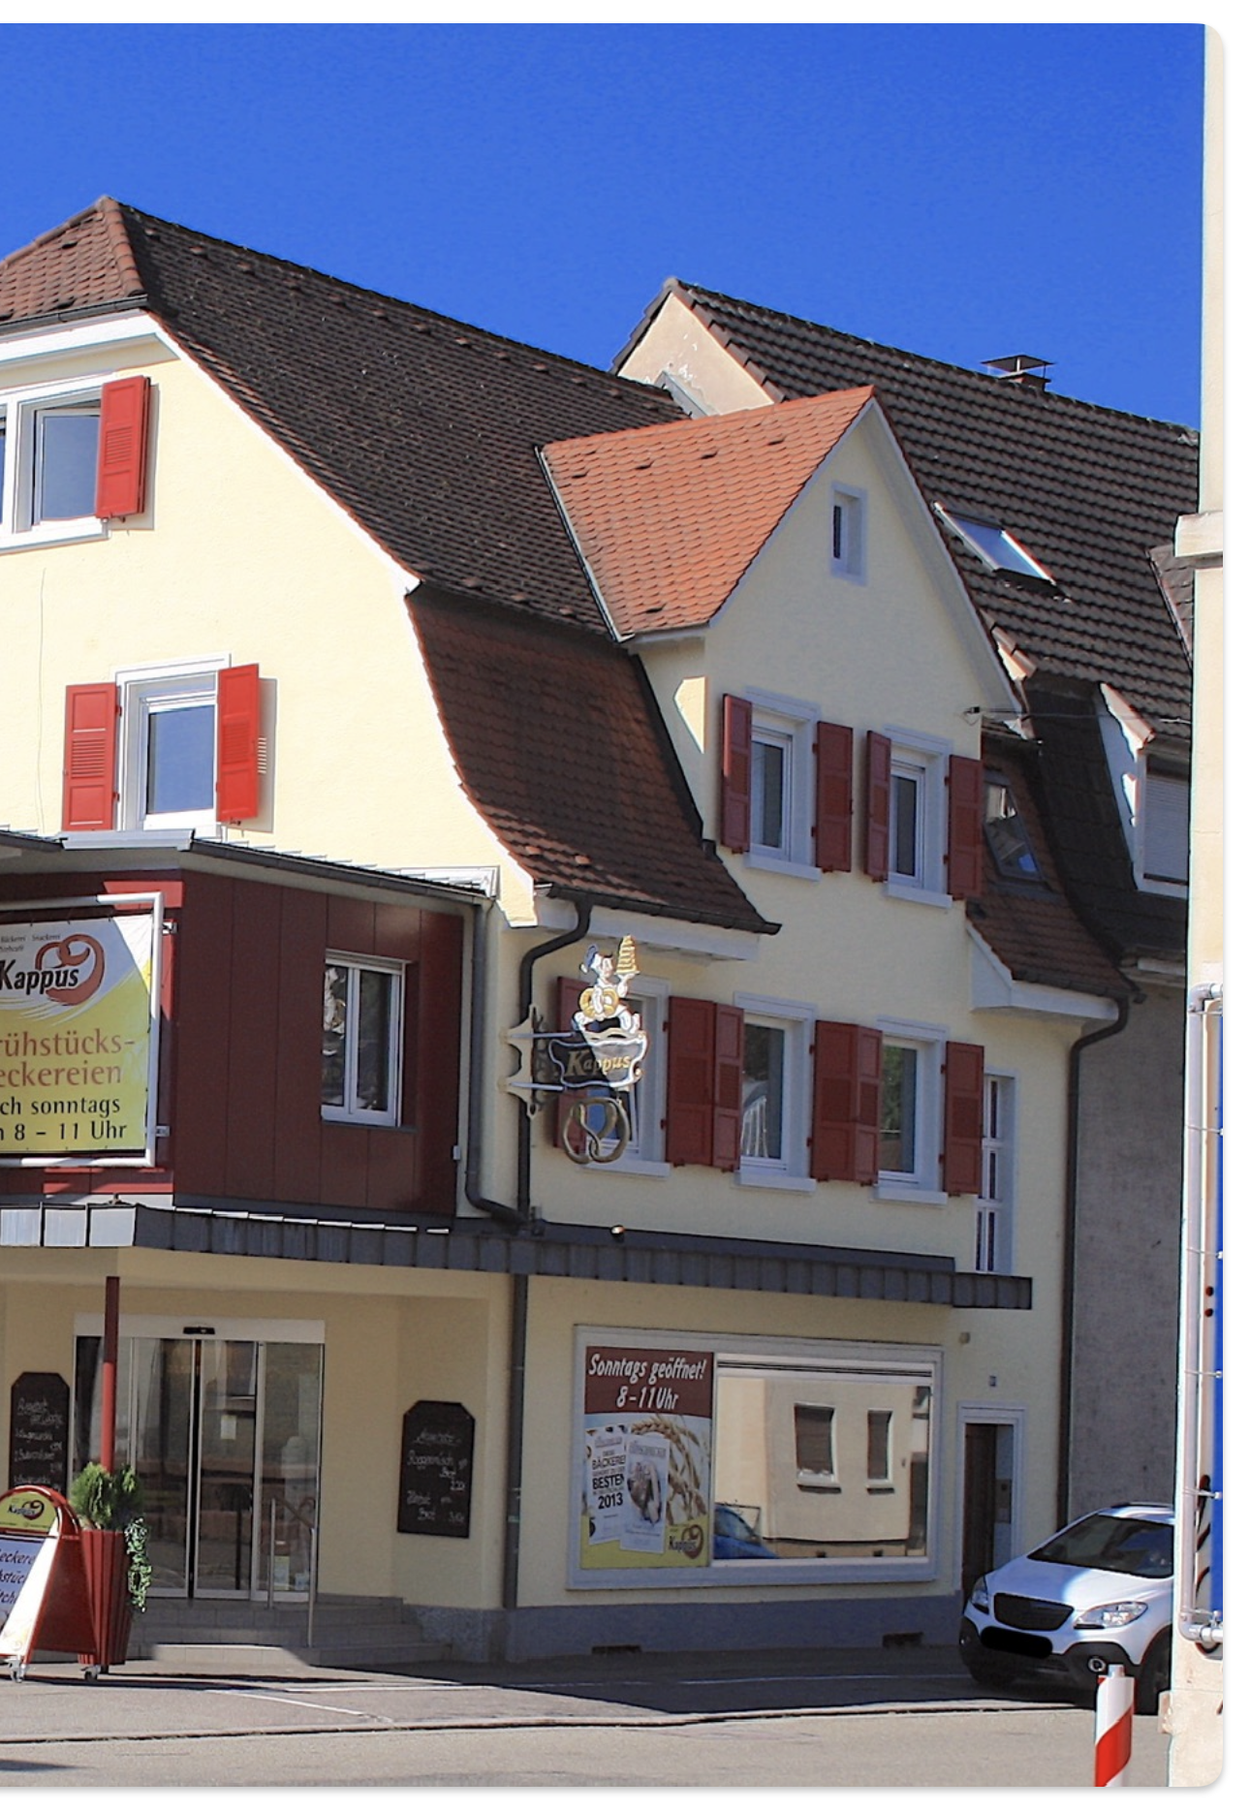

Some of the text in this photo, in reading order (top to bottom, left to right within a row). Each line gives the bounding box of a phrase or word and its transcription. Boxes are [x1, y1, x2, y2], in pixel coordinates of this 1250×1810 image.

[565, 1049, 631, 1076] Kappus
[30, 1097, 121, 1119] sonntags
[14, 1123, 26, 1141] 8
[60, 1122, 79, 1140] 11
[91, 1120, 128, 1140] Uhr
[588, 1353, 707, 1385] Sonntags geöffnet!
[598, 1492, 624, 1510] 2013
